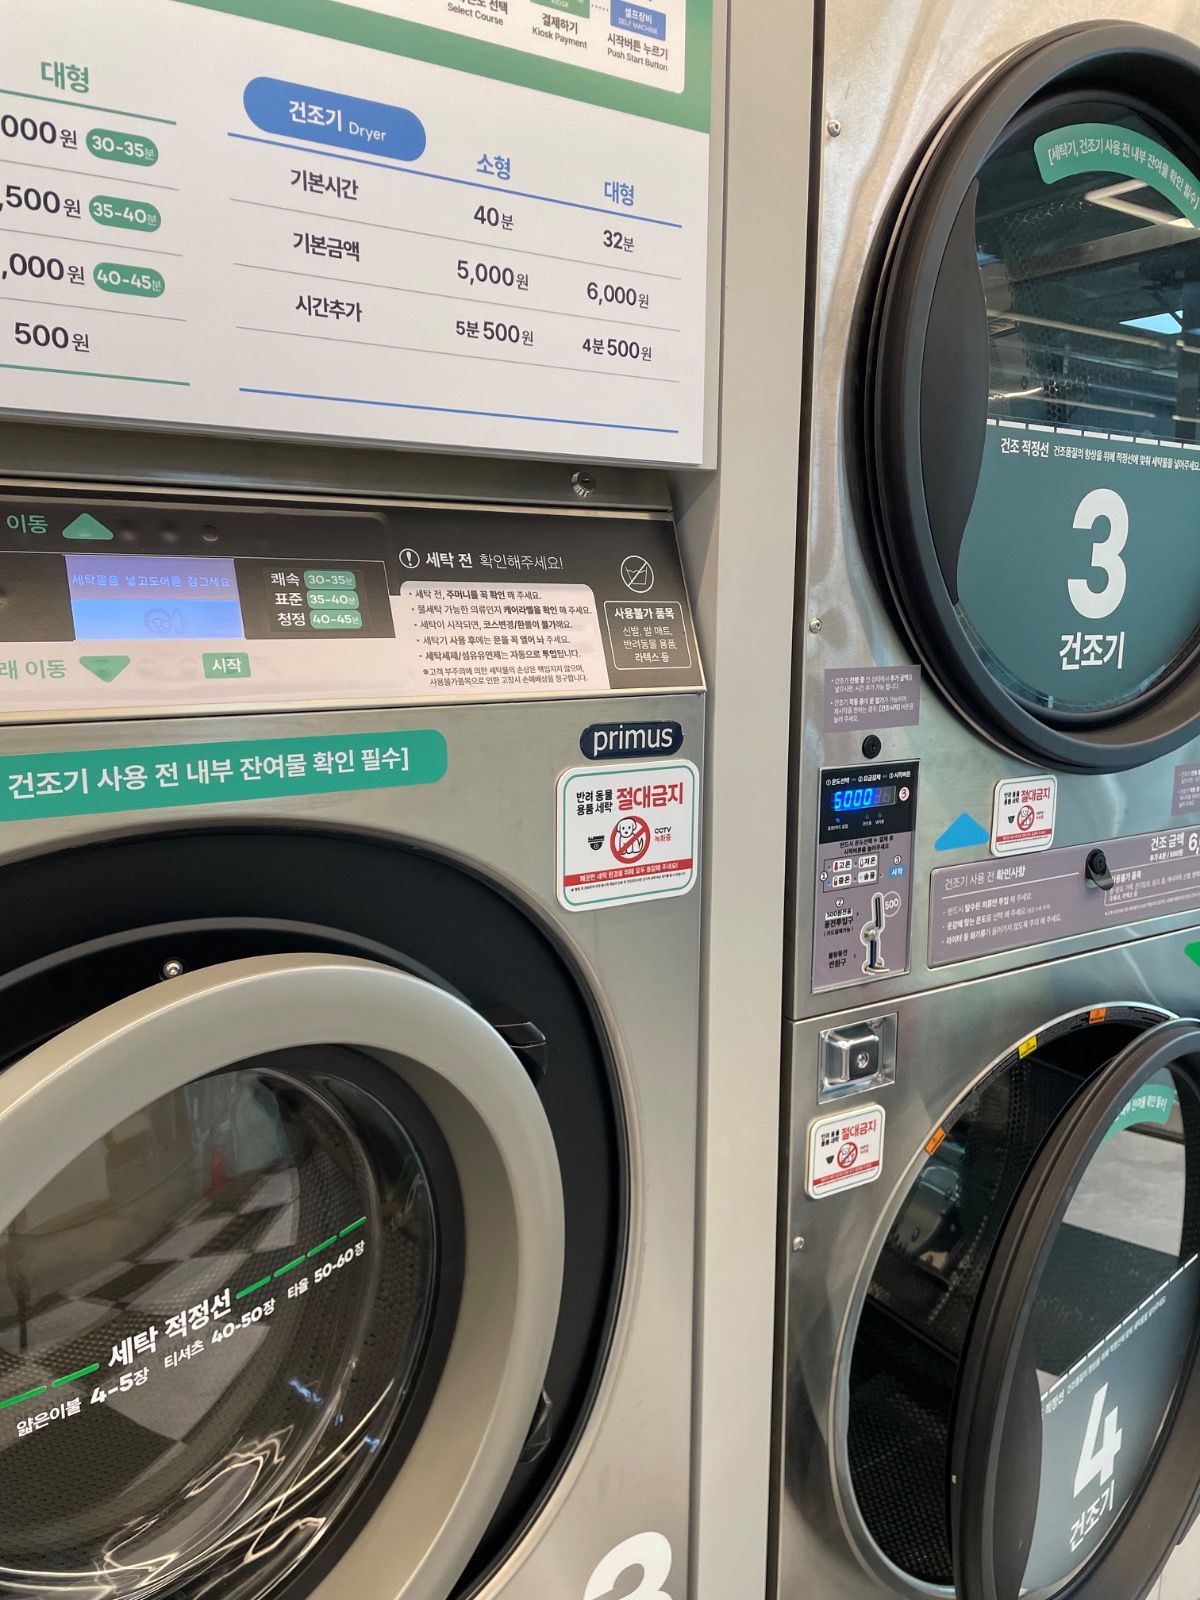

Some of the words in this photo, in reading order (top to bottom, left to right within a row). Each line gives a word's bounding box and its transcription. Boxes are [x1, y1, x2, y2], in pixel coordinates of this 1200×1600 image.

[447, 2, 473, 18] Select
[475, 10, 504, 26] Course
[541, 13, 578, 35] 결제하기
[624, 7, 652, 25] 셀프장비
[618, 17, 631, 28] SELF
[632, 21, 658, 35] MACHINE
[532, 26, 553, 40] Kiosk
[554, 33, 588, 49] Payment
[607, 32, 641, 53] 시작버튼
[643, 42, 668, 60] 누르기
[607, 47, 625, 60] Push
[626, 54, 644, 66] Start
[645, 59, 668, 72] Button
[40, 60, 90, 94] 대형
[288, 99, 343, 132] 건조기
[349, 121, 387, 142] Dryer
[476, 153, 512, 181] 소형
[1079, 138, 1103, 154] 건조기
[1105, 139, 1121, 155] 사용
[1122, 142, 1130, 158] 전
[1131, 146, 1146, 164] 내부
[1147, 153, 1169, 178] 잔여물
[1169, 169, 1184, 191] 확인
[290, 169, 359, 201] 기본시간
[603, 181, 635, 207] 대형
[473, 205, 514, 231] 40분
[292, 231, 361, 262] 기본금액
[602, 230, 635, 253] 32분
[456, 259, 530, 291] 5,000원
[586, 282, 650, 309] 6,000원
[295, 295, 363, 323] 시간추가
[13, 321, 90, 353] 500원
[1001, 437, 1020, 455] 건조
[1021, 439, 1049, 458] 적정선
[1053, 445, 1083, 460] 건조품질의
[1085, 447, 1103, 462] 향상을
[1103, 450, 1115, 463] 위해
[1116, 452, 1139, 466] 적정선에
[6, 514, 48, 534] 이동
[426, 552, 454, 568] 세탁
[458, 553, 473, 568] 전
[480, 554, 564, 570] 확인해주세요!
[1067, 488, 1129, 619] 3
[188, 577, 230, 587] 잠그세요
[271, 572, 300, 586] 쾌속
[275, 592, 303, 606] 표준
[415, 590, 431, 599] 세탁
[433, 590, 445, 600] 전,
[447, 591, 478, 600] 주머니를
[480, 592, 489, 600] 꼭
[490, 591, 505, 600] 확인
[507, 592, 515, 600] 해
[517, 592, 541, 600] 주세요.
[277, 612, 306, 627] 청정
[418, 605, 442, 614] 물세탁
[444, 605, 469, 614] 가능한
[471, 606, 502, 615] 의류인지
[503, 606, 541, 615] 케어라벨을
[543, 606, 557, 615] 확인
[559, 607, 567, 615] 해
[614, 607, 653, 620] 사용불가
[655, 607, 675, 620] 품목
[420, 620, 445, 629] 세탁이
[447, 620, 481, 630] 시작되면,
[643, 626, 652, 637] 발
[423, 636, 447, 645] 세탁기
[450, 636, 466, 645] 사용
[468, 635, 491, 645] 후에는
[493, 636, 509, 645] 문을
[510, 636, 518, 645] 꼭
[520, 635, 535, 645] 열어
[623, 639, 657, 650] 반려동물
[1059, 631, 1125, 671] 건조기
[510, 650, 541, 659] 자동으로
[542, 649, 581, 659] 투입됩니다.
[635, 652, 660, 663] 라텍스
[661, 652, 669, 663] 등
[25, 660, 67, 679] 이동
[212, 658, 242, 673] 시작
[593, 724, 673, 757] primus
[8, 769, 89, 799] 건조기
[96, 764, 148, 792] 사용
[154, 762, 179, 788] 전
[186, 760, 234, 786] 내부
[239, 752, 307, 781] 잔여물
[312, 749, 355, 776] 확인
[360, 746, 409, 772] 필수]
[576, 790, 593, 803] 반려
[595, 789, 613, 802] 동물
[616, 782, 684, 812] 절대금지
[1021, 787, 1050, 803] 절대금지
[576, 804, 594, 816] 용품
[595, 802, 613, 814] 세탁
[654, 826, 672, 835] CCTV
[1150, 836, 1166, 852] 건조
[1168, 832, 1184, 848] 금액
[838, 861, 851, 870] 고온
[944, 875, 968, 890] 건조기
[970, 872, 985, 886] 사용
[987, 872, 995, 883] 전
[996, 865, 1025, 881] 확인사항
[885, 898, 898, 910] 500
[824, 916, 853, 928] 동전투입구
[841, 1119, 876, 1140] 절대금지
[16, 1396, 82, 1438] 얇은이불
[89, 1366, 150, 1405] 4-5장
[163, 1339, 205, 1369] 티셔츠
[210, 1298, 276, 1345] 40-50장
[313, 1239, 366, 1284] 50-60장
[107, 1326, 159, 1368] 세탁
[164, 1287, 232, 1338] 적정선
[1073, 1382, 1122, 1499] 4
[1070, 1479, 1115, 1553] 건조기
